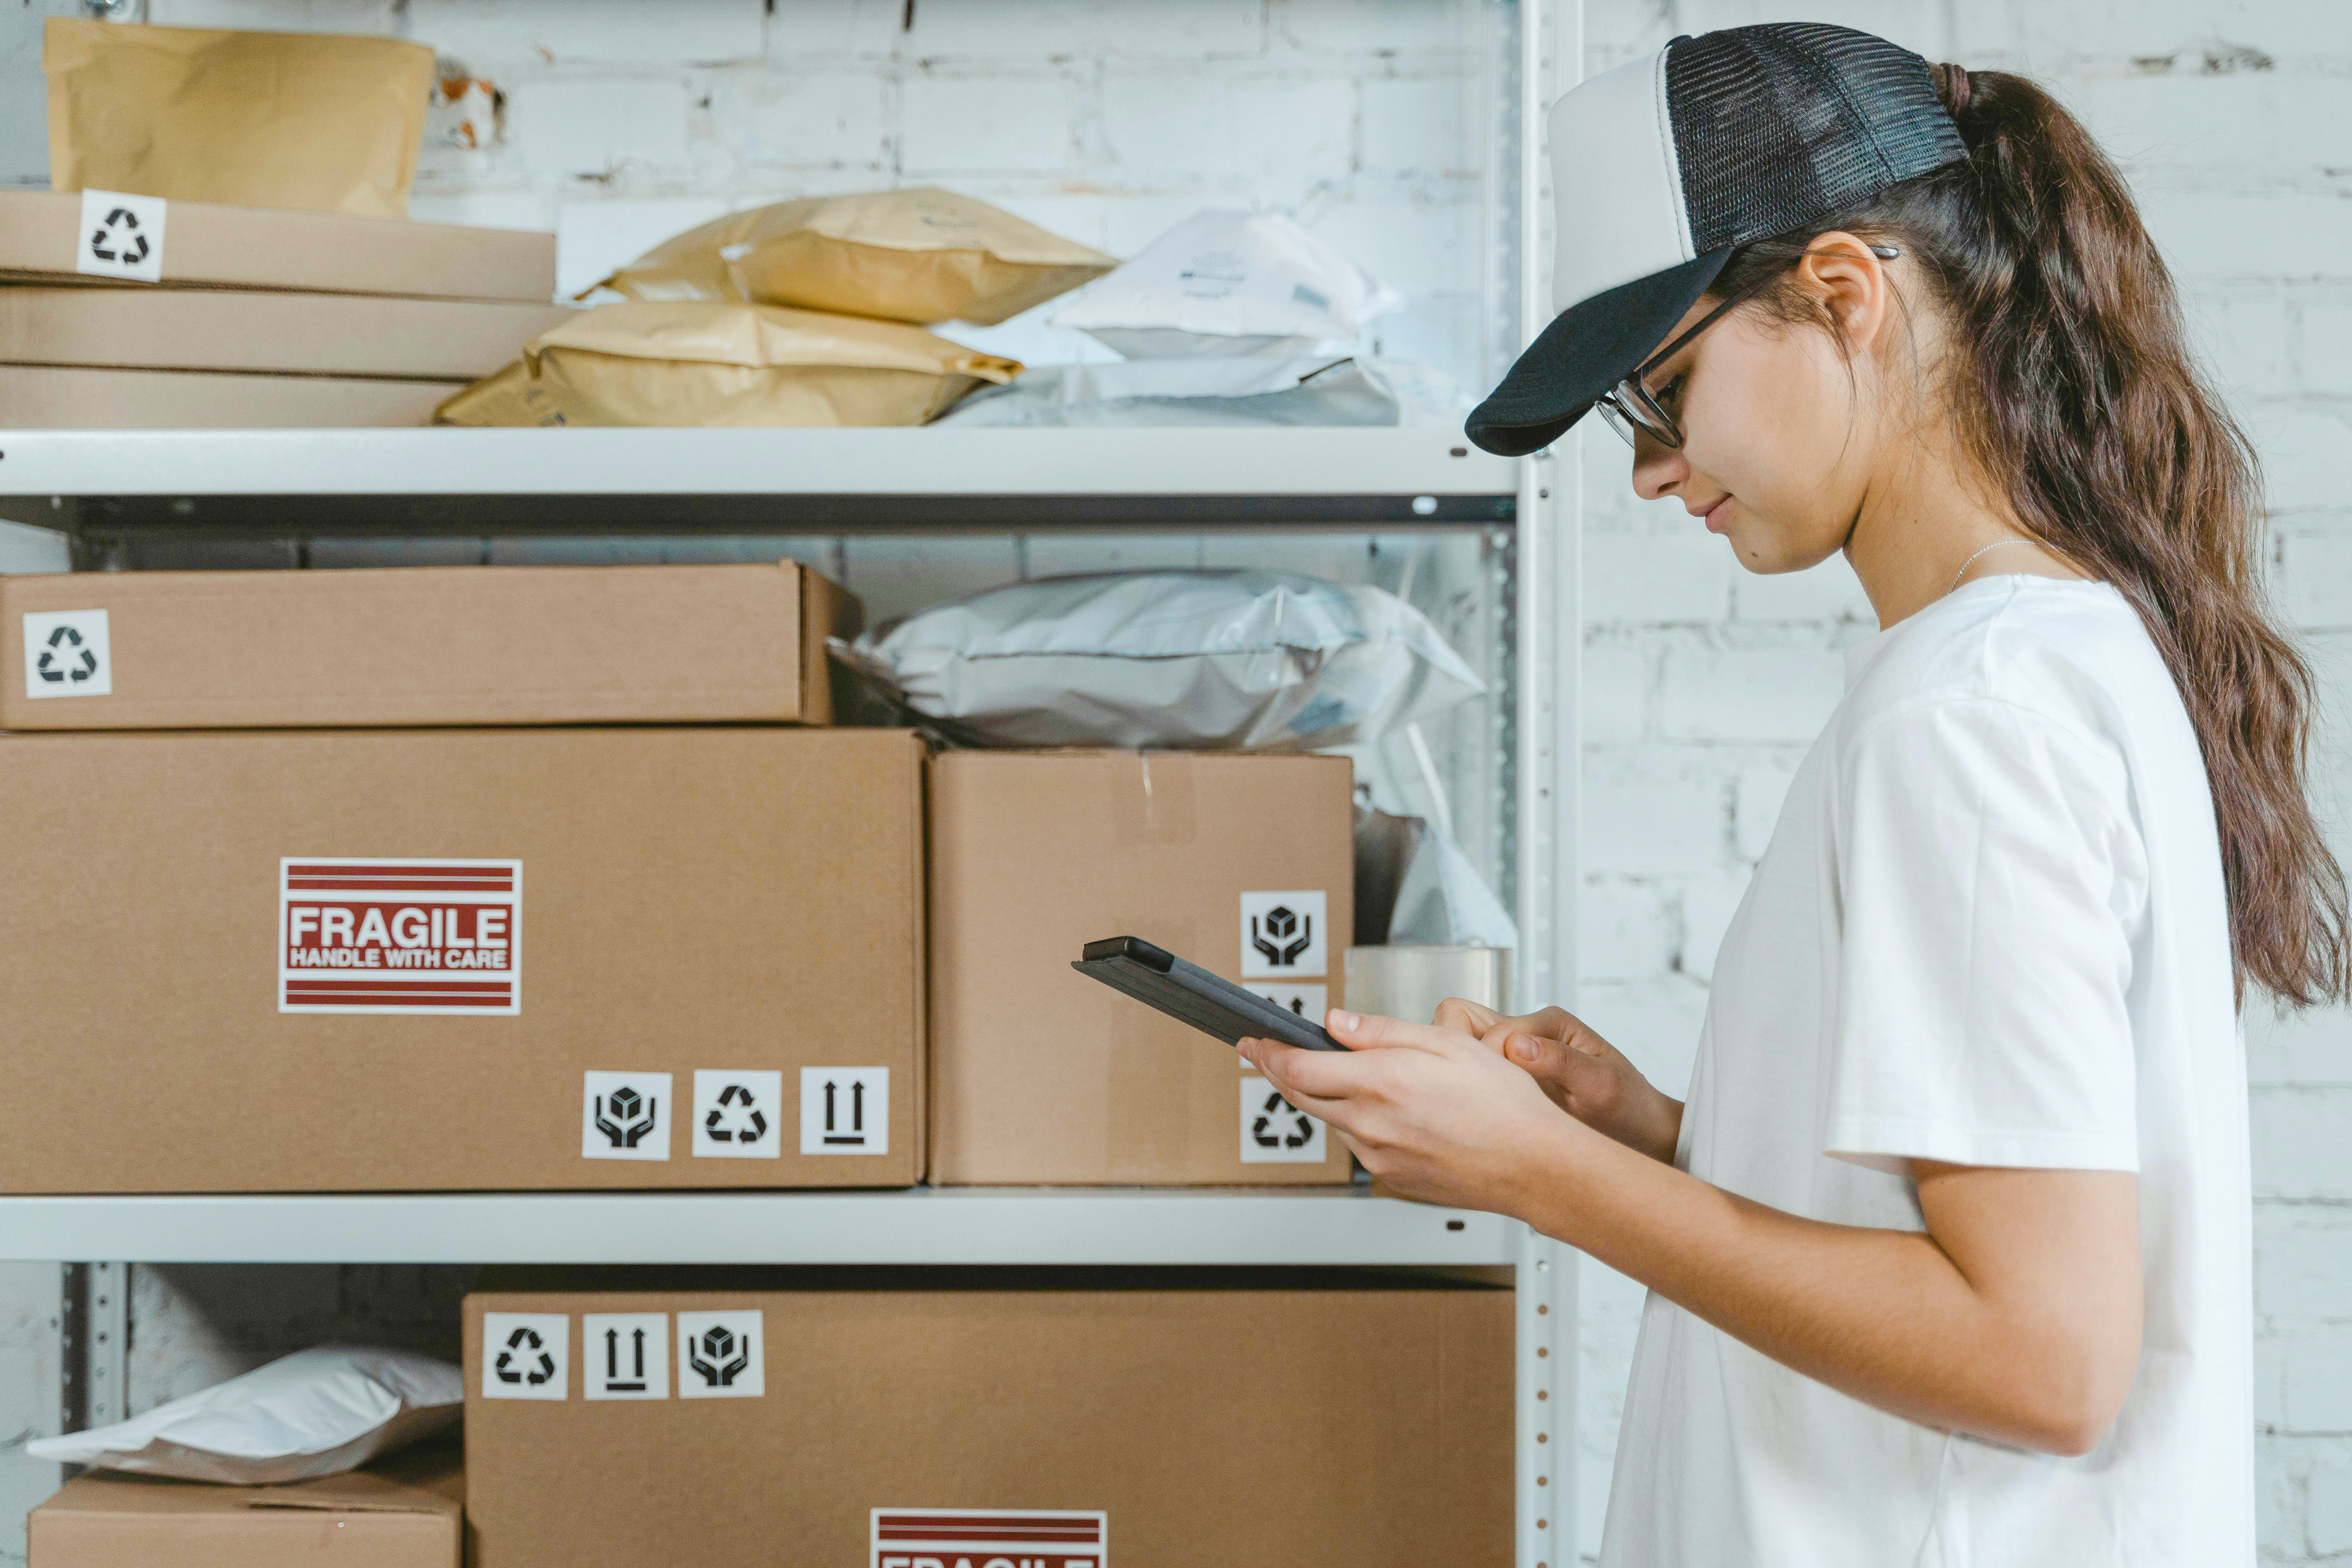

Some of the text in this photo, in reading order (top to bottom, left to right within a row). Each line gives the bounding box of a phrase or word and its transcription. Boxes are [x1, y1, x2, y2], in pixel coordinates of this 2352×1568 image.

[290, 907, 508, 948] FRAGILE
[291, 947, 508, 969] HANDLE WITH CARE
